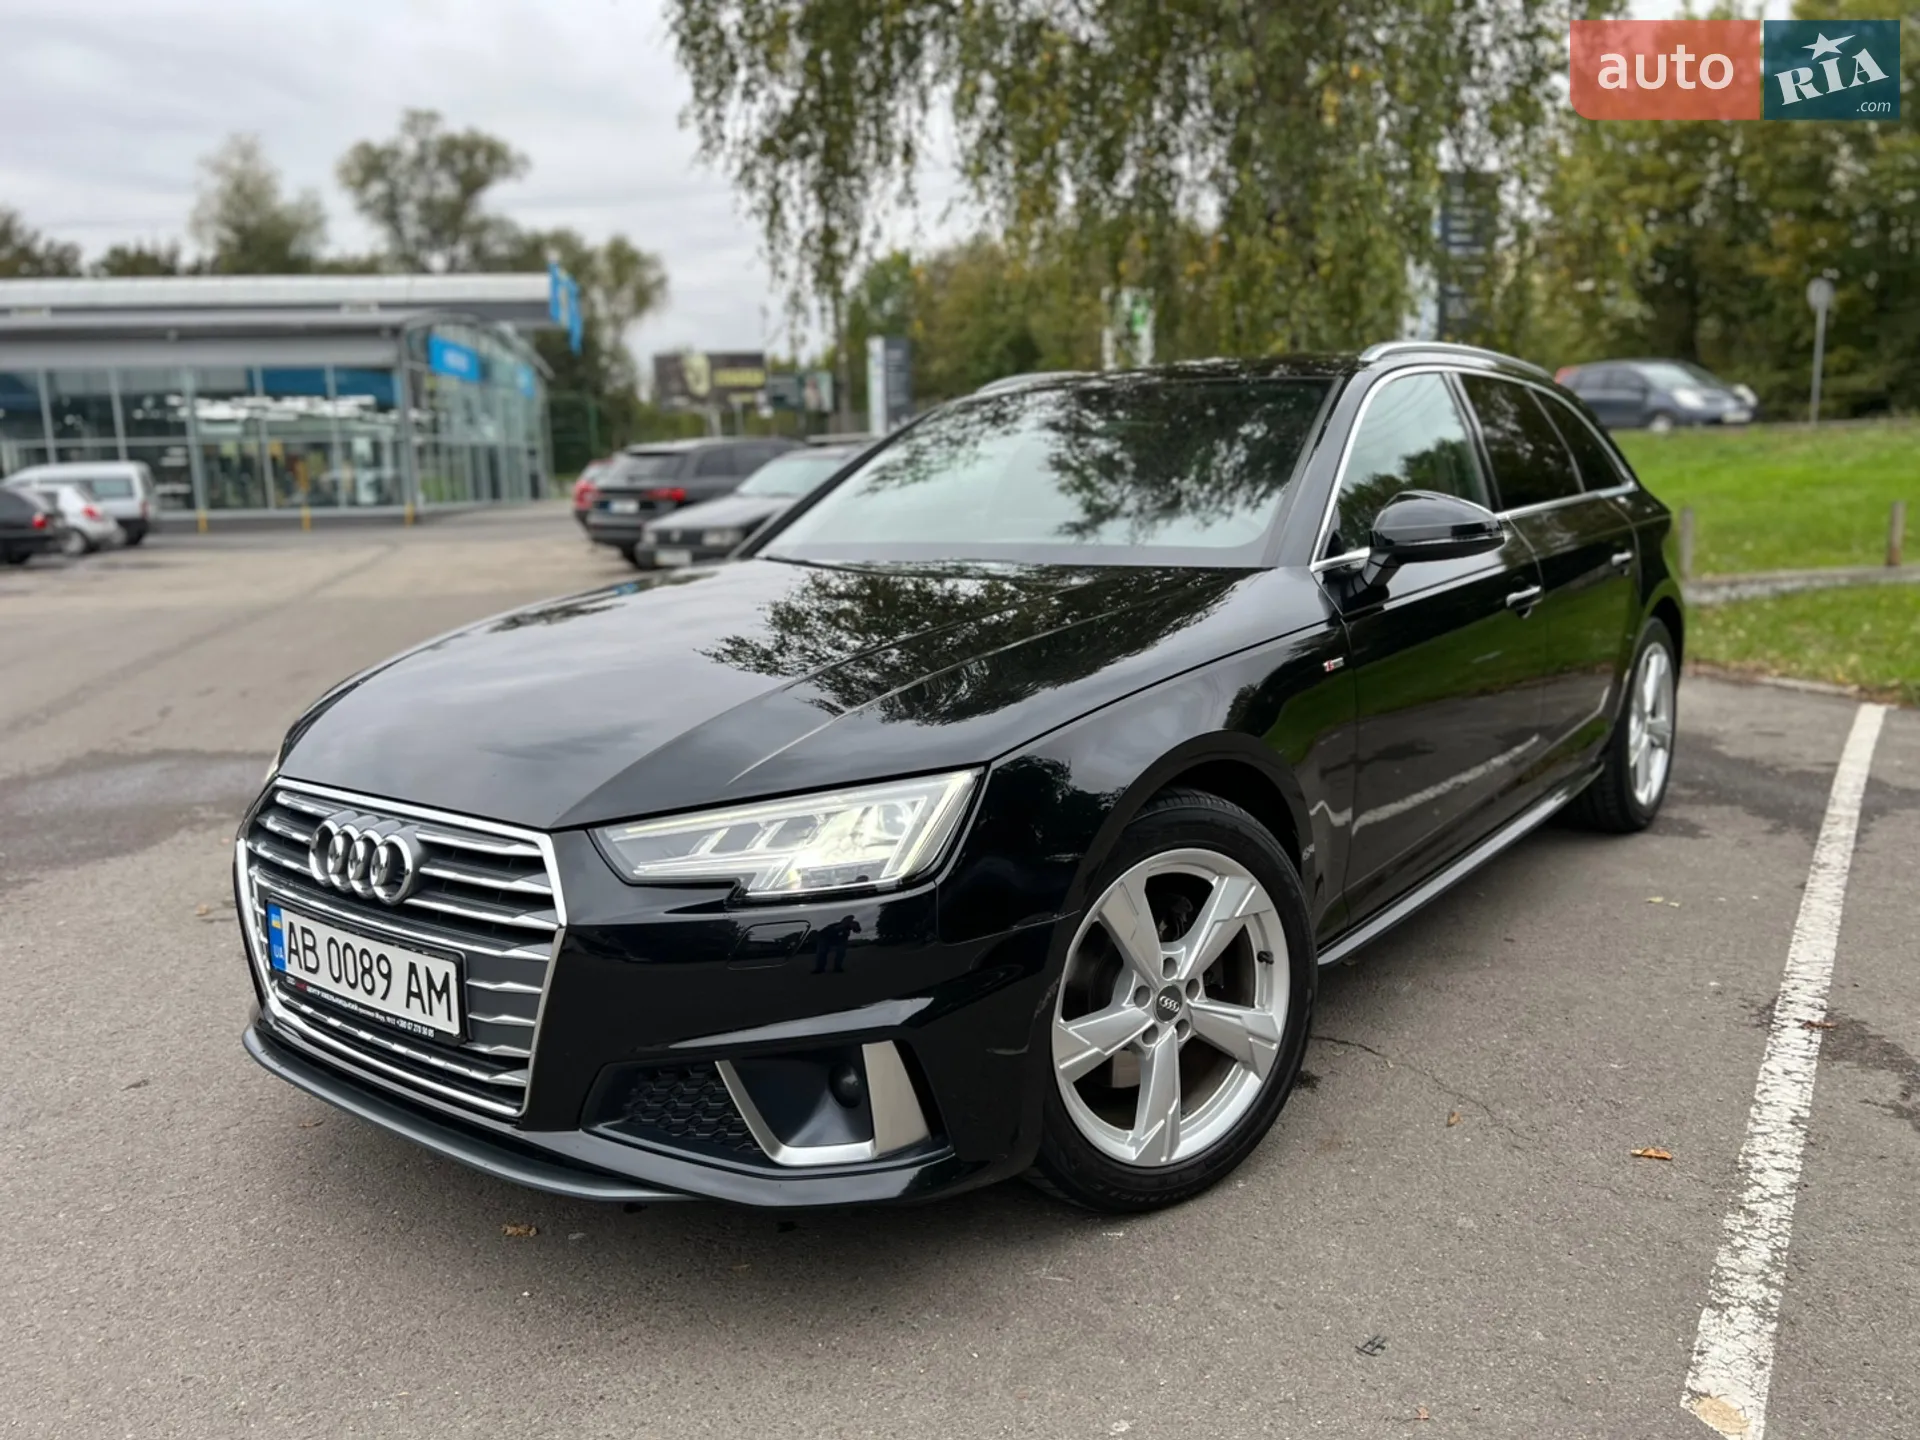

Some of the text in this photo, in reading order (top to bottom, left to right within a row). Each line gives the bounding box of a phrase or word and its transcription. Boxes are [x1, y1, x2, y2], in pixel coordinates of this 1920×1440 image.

[273, 944, 284, 959] UA
[287, 921, 453, 1022] AB 0089 AM
